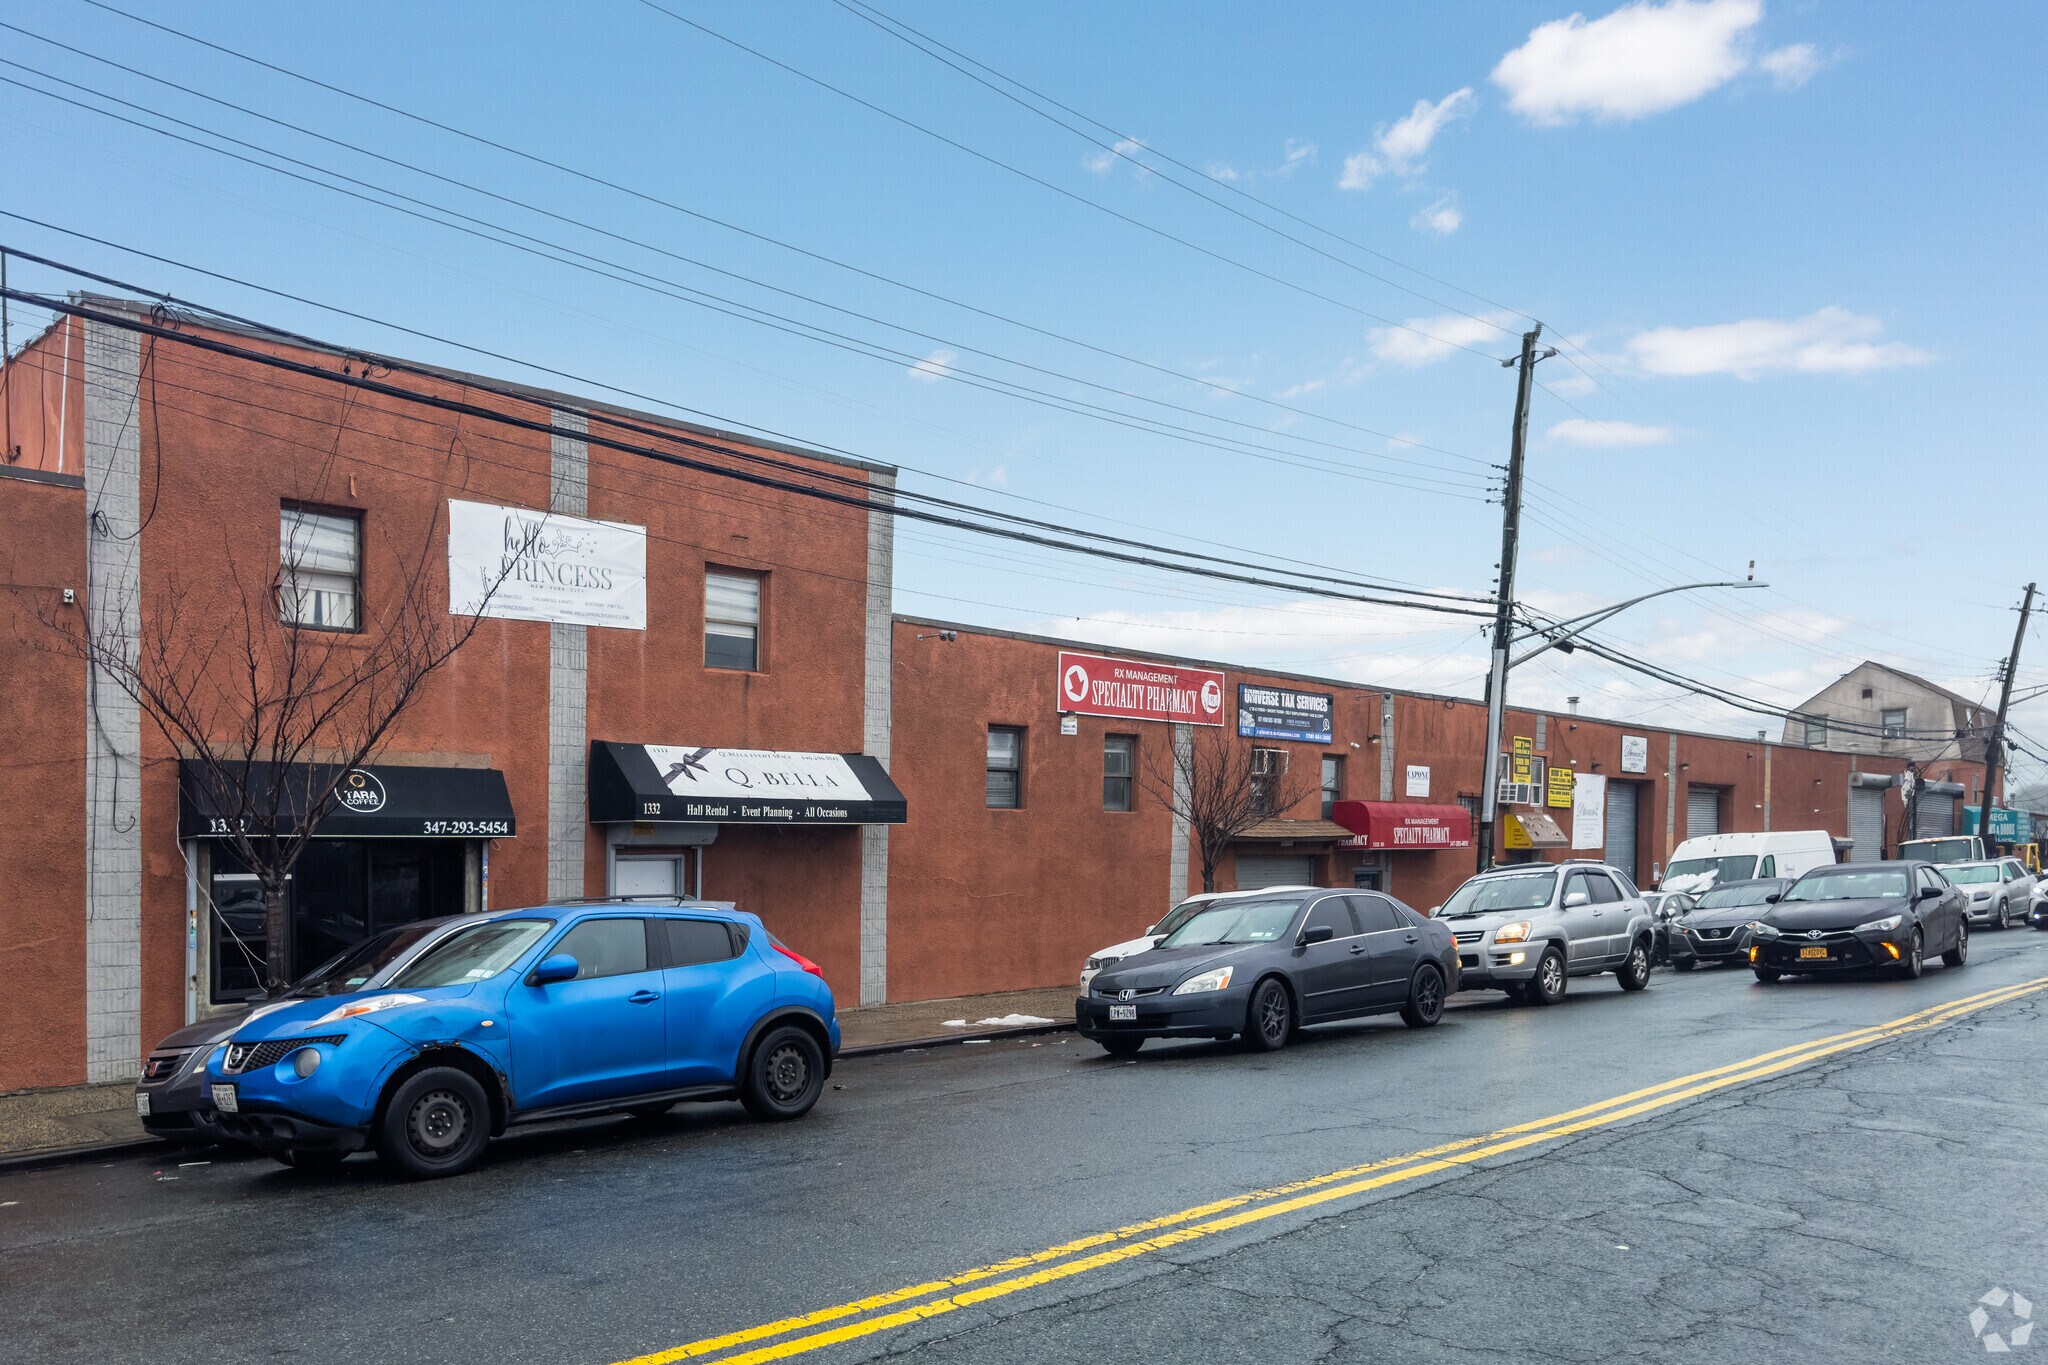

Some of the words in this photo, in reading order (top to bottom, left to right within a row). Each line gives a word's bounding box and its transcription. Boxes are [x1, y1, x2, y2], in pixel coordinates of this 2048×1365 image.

[504, 516, 549, 559] hello
[501, 556, 612, 590] PRINCESS
[1114, 668, 1125, 679] RX
[1125, 669, 1178, 685] MANAGEMENT
[1092, 679, 1145, 710] SPECIALTY
[1146, 685, 1198, 715] PHARMACY
[1244, 688, 1280, 707] UNIVERSE
[1281, 692, 1295, 709] TAX
[1296, 695, 1329, 713] SERVICES
[761, 771, 839, 788] BELLA
[1407, 770, 1429, 779] CAPONE
[344, 790, 378, 800] TARA
[347, 798, 380, 806] COFFEE
[643, 802, 661, 815] 1332
[687, 804, 703, 816] Hall
[705, 804, 729, 817] Rental
[741, 805, 761, 818] Event
[763, 806, 793, 820] Planning
[804, 807, 815, 818] All
[816, 806, 848, 819] Occasions
[423, 821, 509, 834] 347-293-5454
[1394, 827, 1421, 844] SPECIALTY
[1422, 827, 1450, 844] PHARMACY
